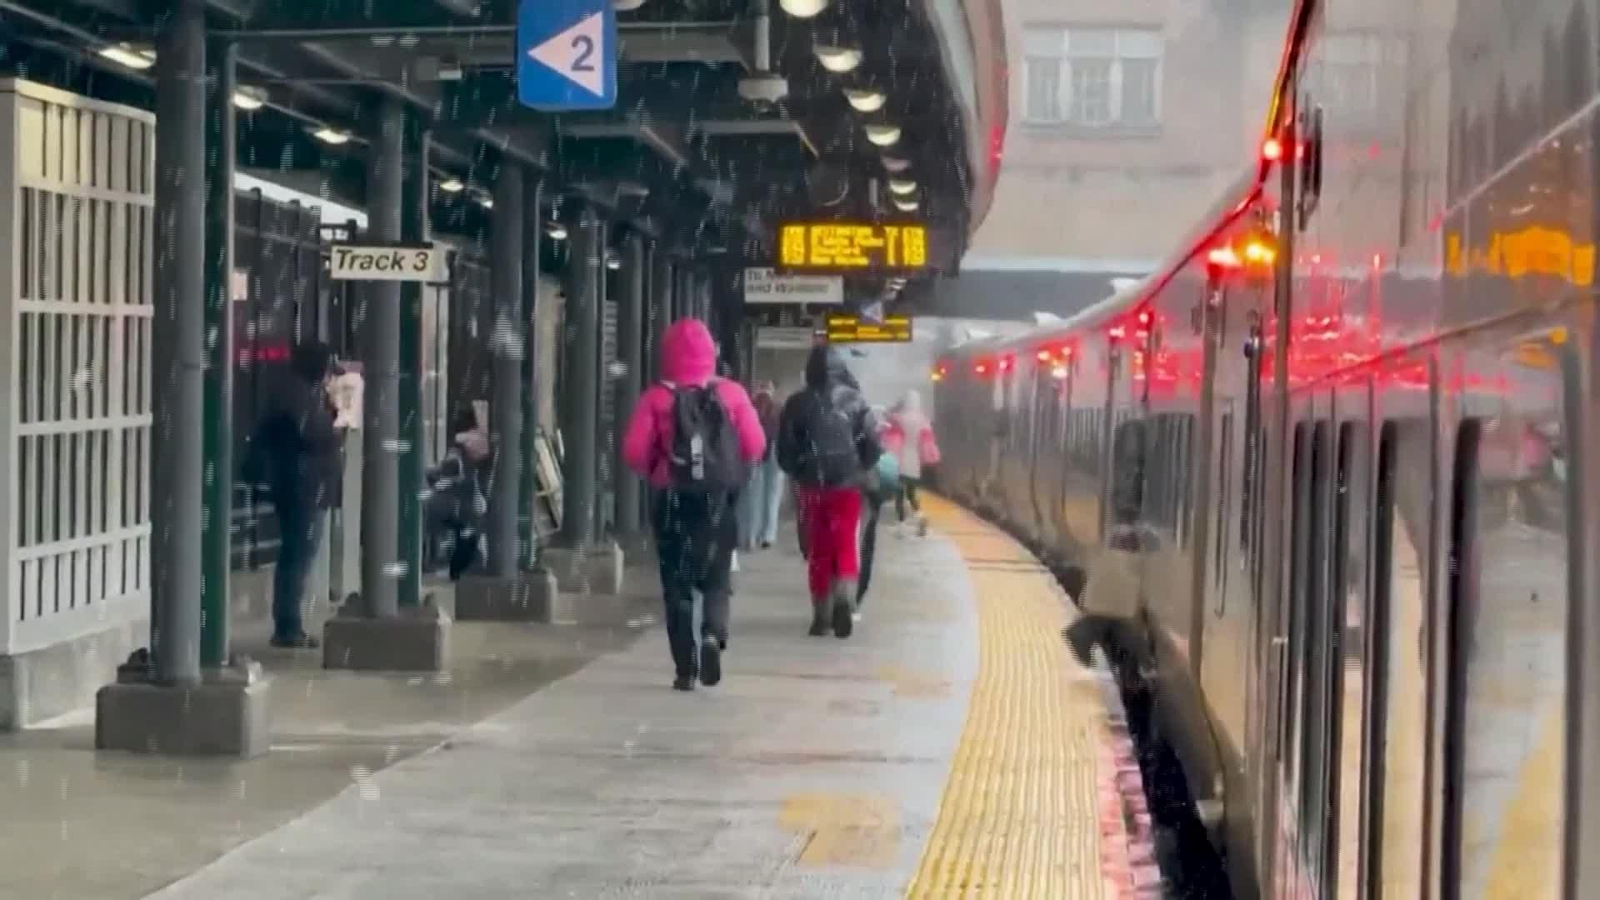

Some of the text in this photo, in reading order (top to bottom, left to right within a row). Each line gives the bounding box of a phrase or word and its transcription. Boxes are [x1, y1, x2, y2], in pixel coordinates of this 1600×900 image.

[571, 34, 595, 71] 2
[336, 249, 429, 272] Track 3
